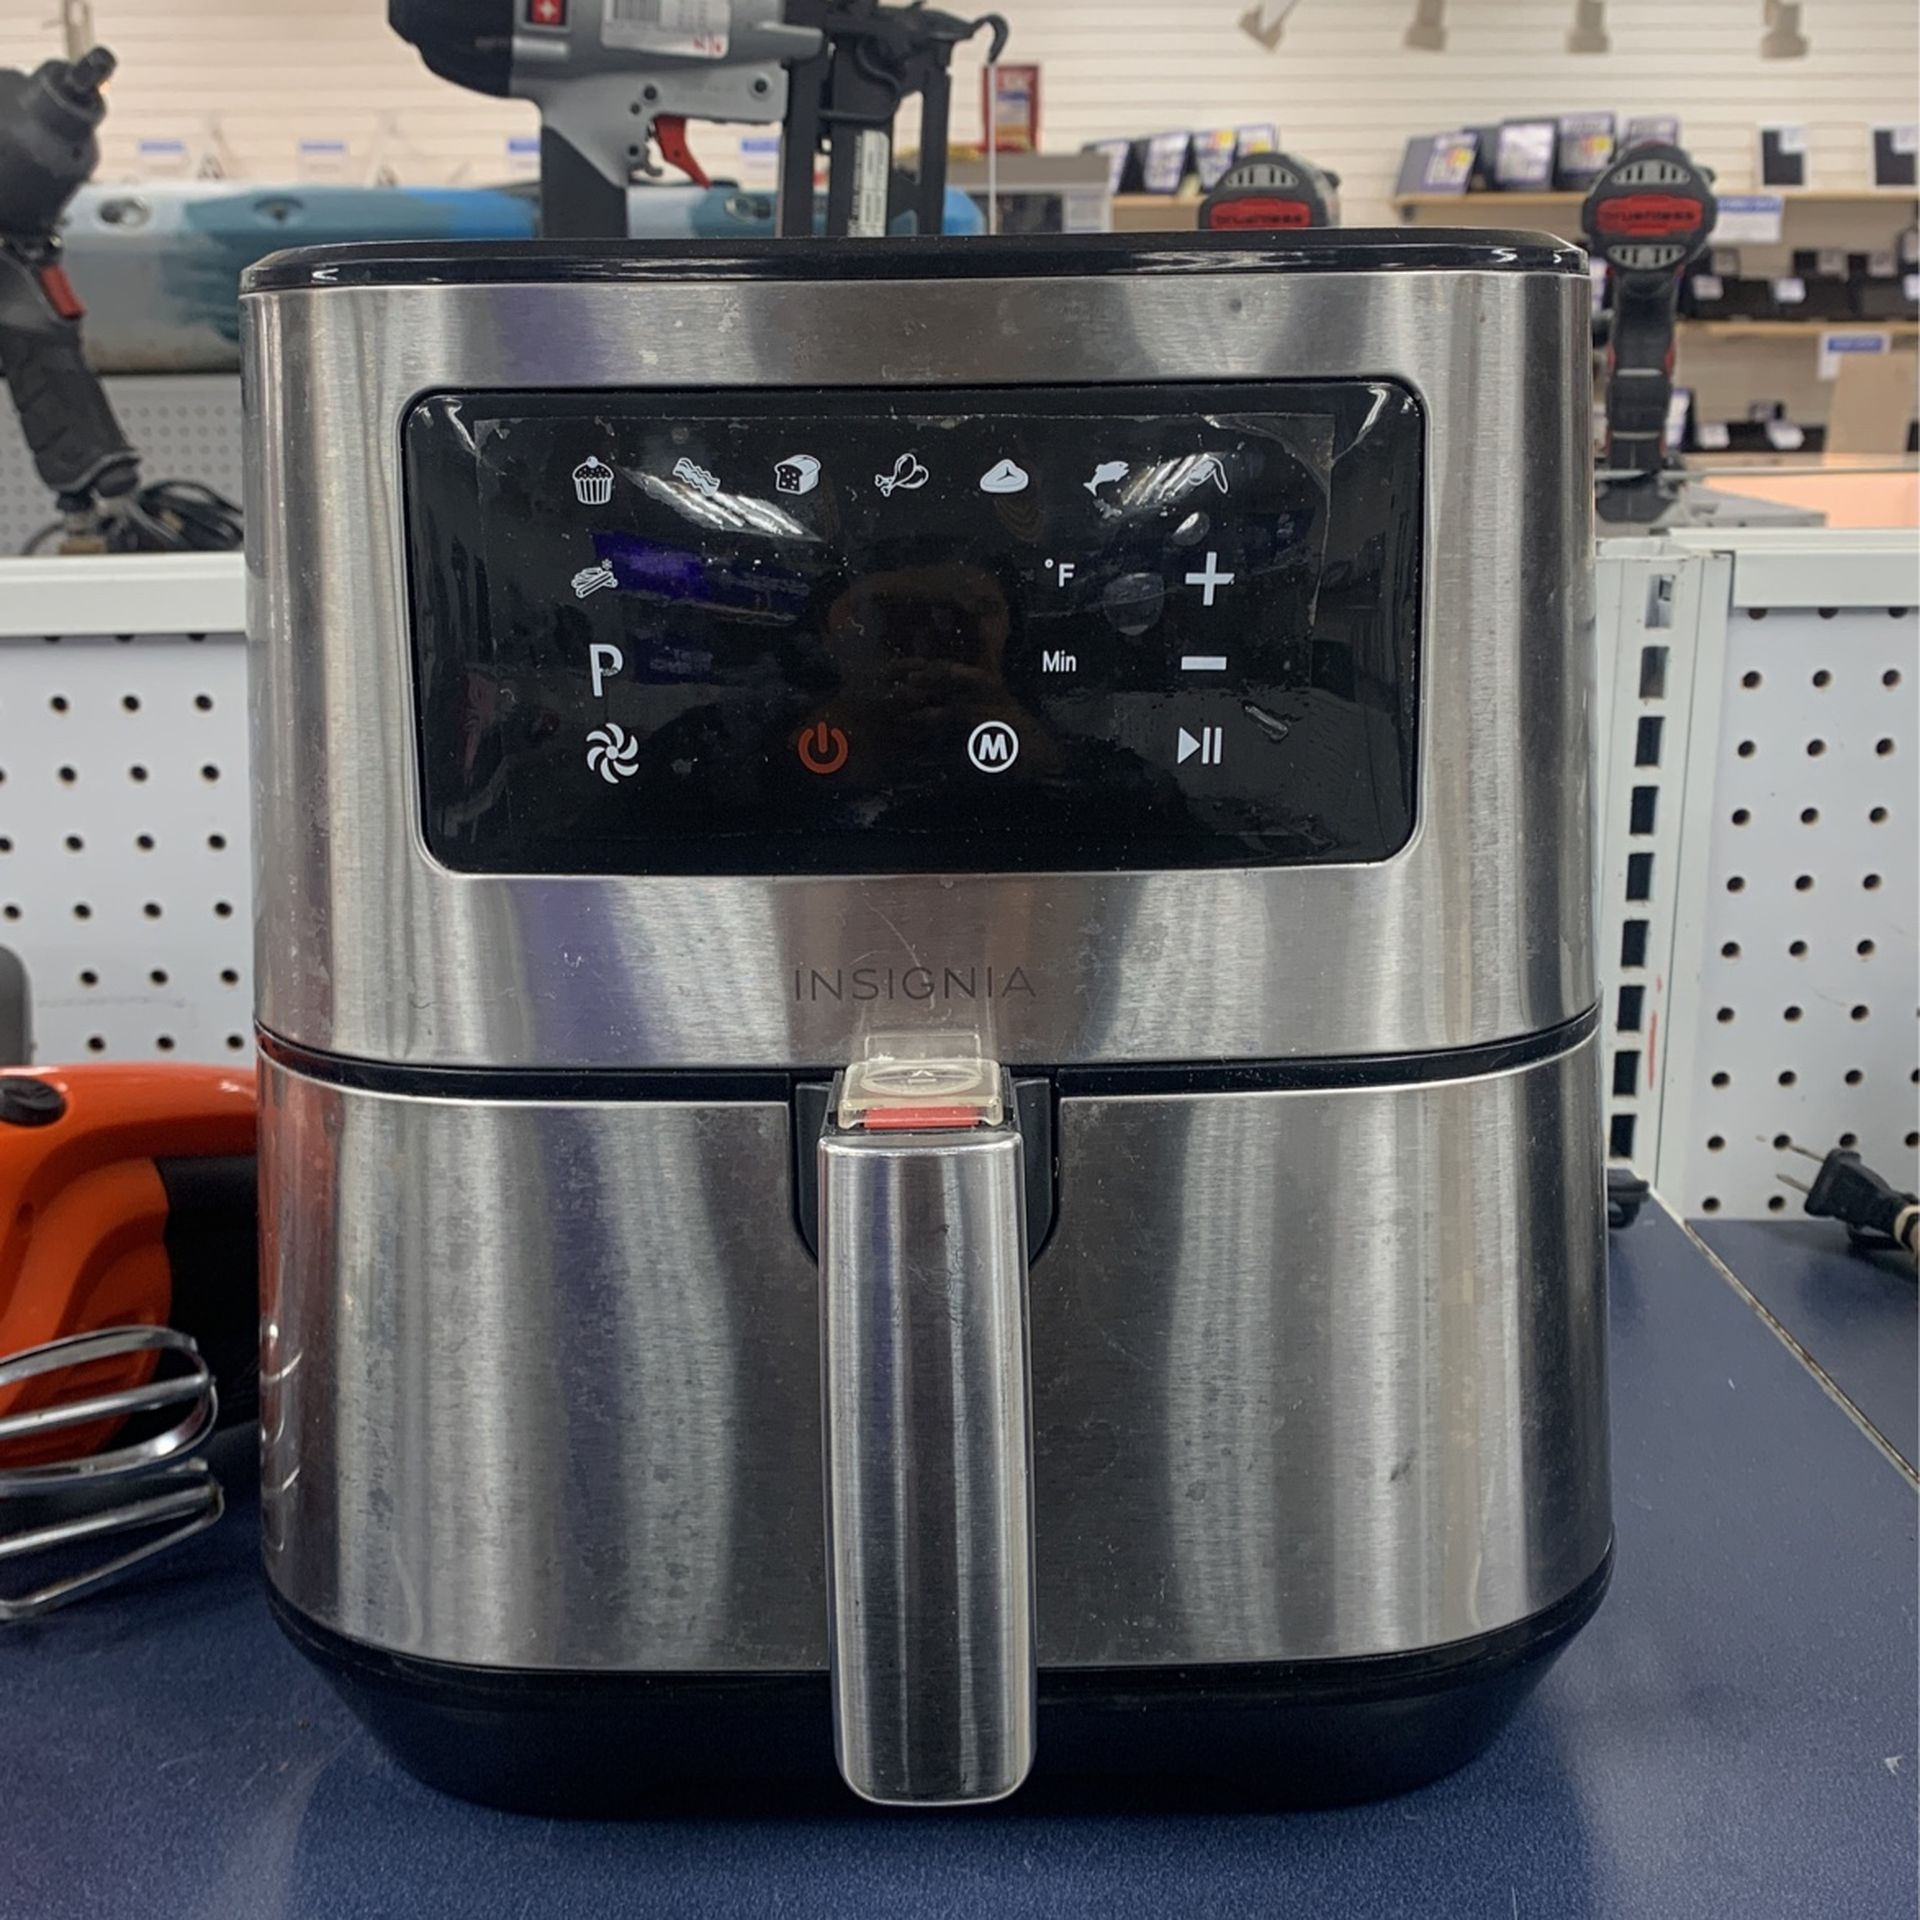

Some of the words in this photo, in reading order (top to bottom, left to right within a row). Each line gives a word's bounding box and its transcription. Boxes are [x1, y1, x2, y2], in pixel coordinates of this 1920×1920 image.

[589, 643, 623, 697] P
[1042, 650, 1077, 672] Min
[795, 966, 1036, 1001] INSIGNIA
